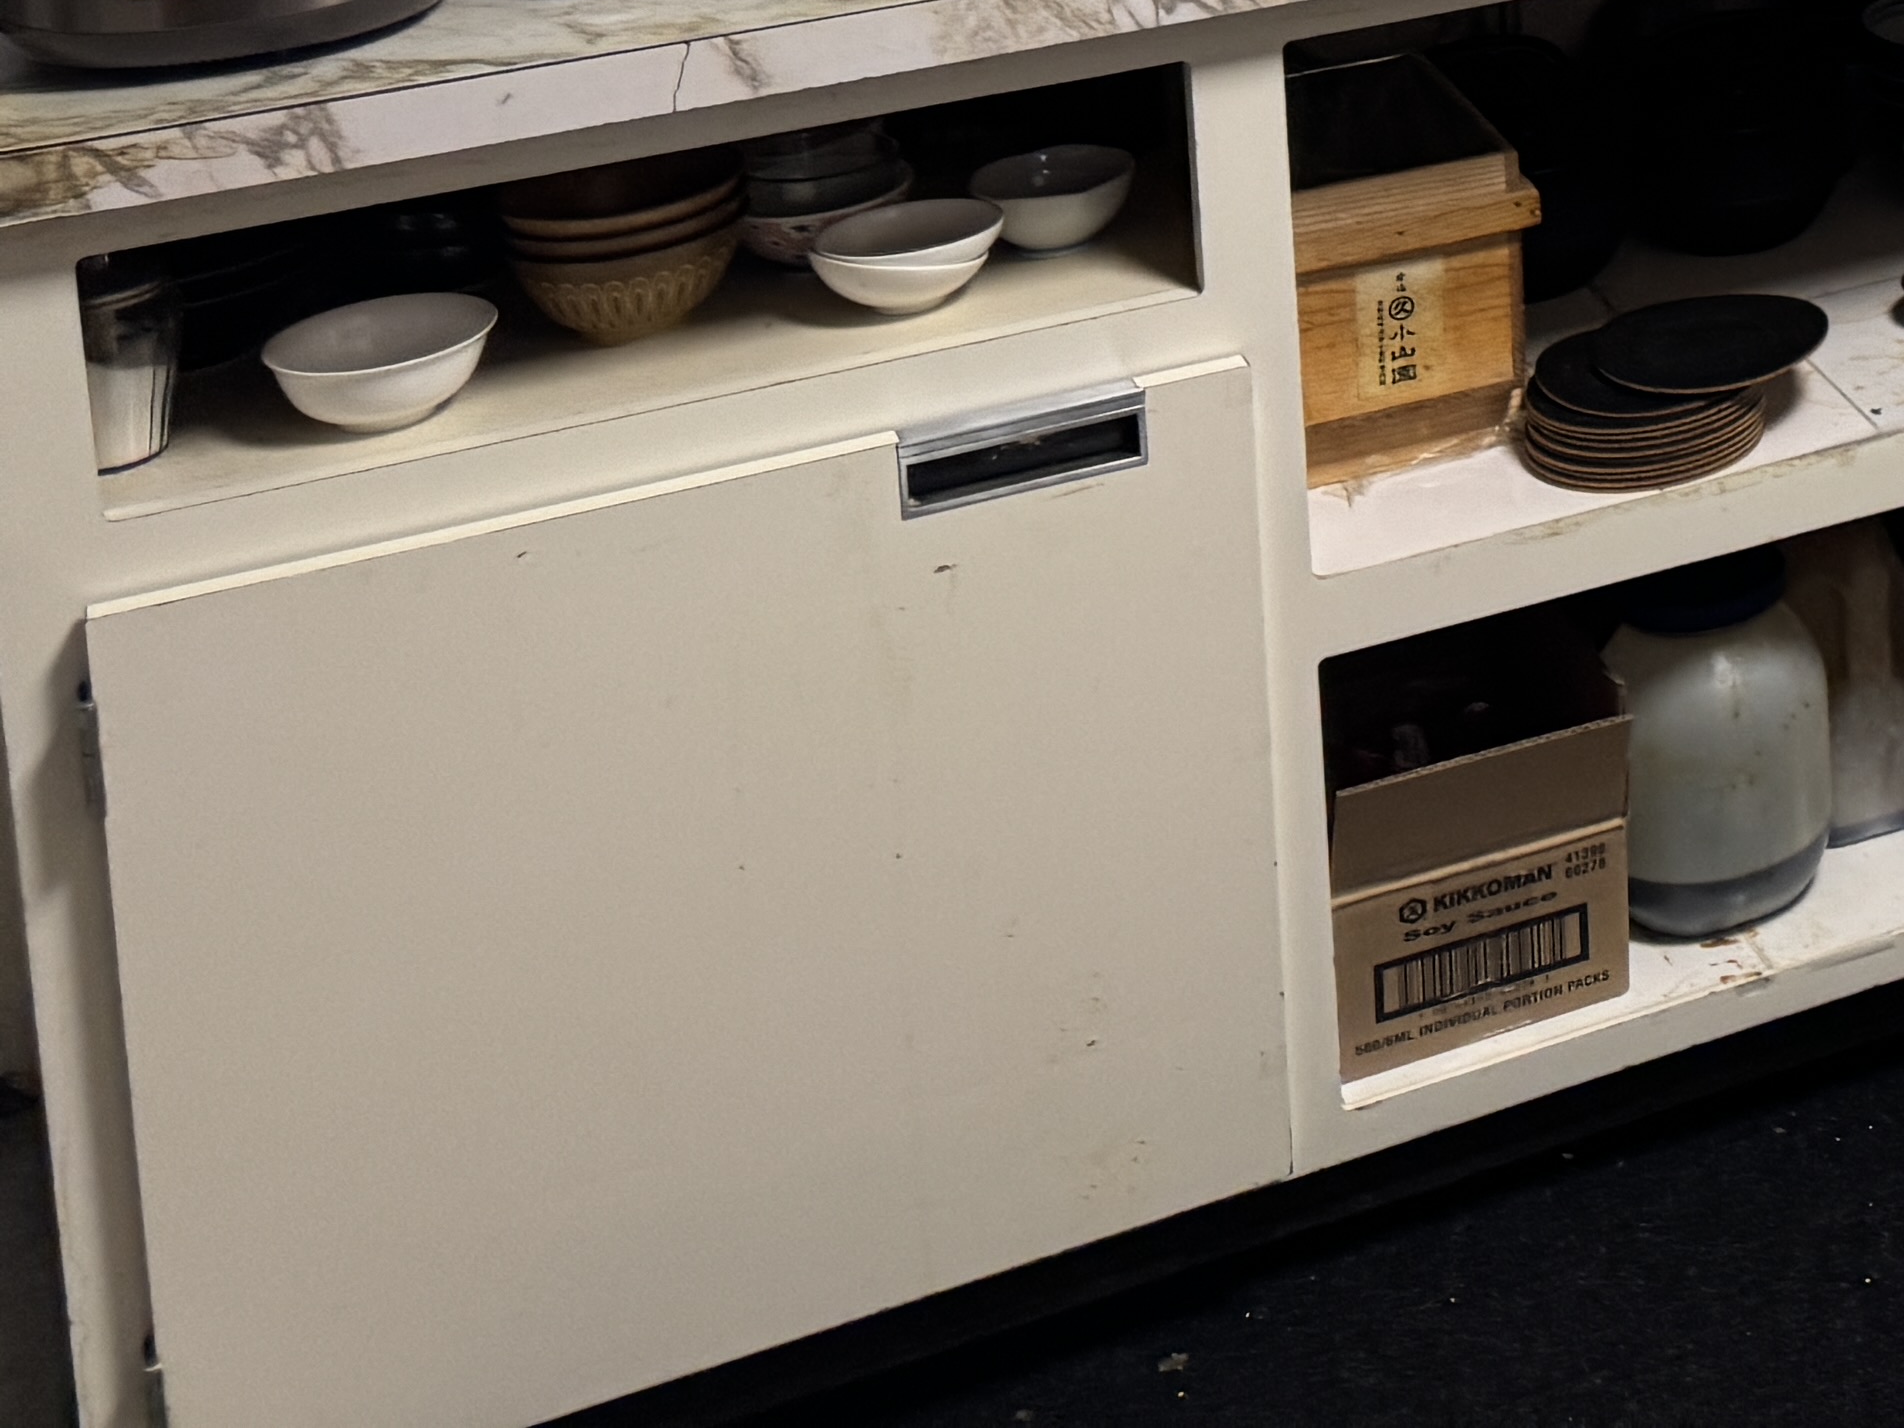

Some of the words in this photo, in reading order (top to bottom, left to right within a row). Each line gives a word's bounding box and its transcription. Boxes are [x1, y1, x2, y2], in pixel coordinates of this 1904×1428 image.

[1403, 919, 1457, 943] Soy
[1468, 890, 1558, 925] Sauce
[1418, 1006, 1497, 1037] INDIVIDUAL
[1503, 985, 1563, 1013] PORTION
[1568, 968, 1610, 995] PACKS
